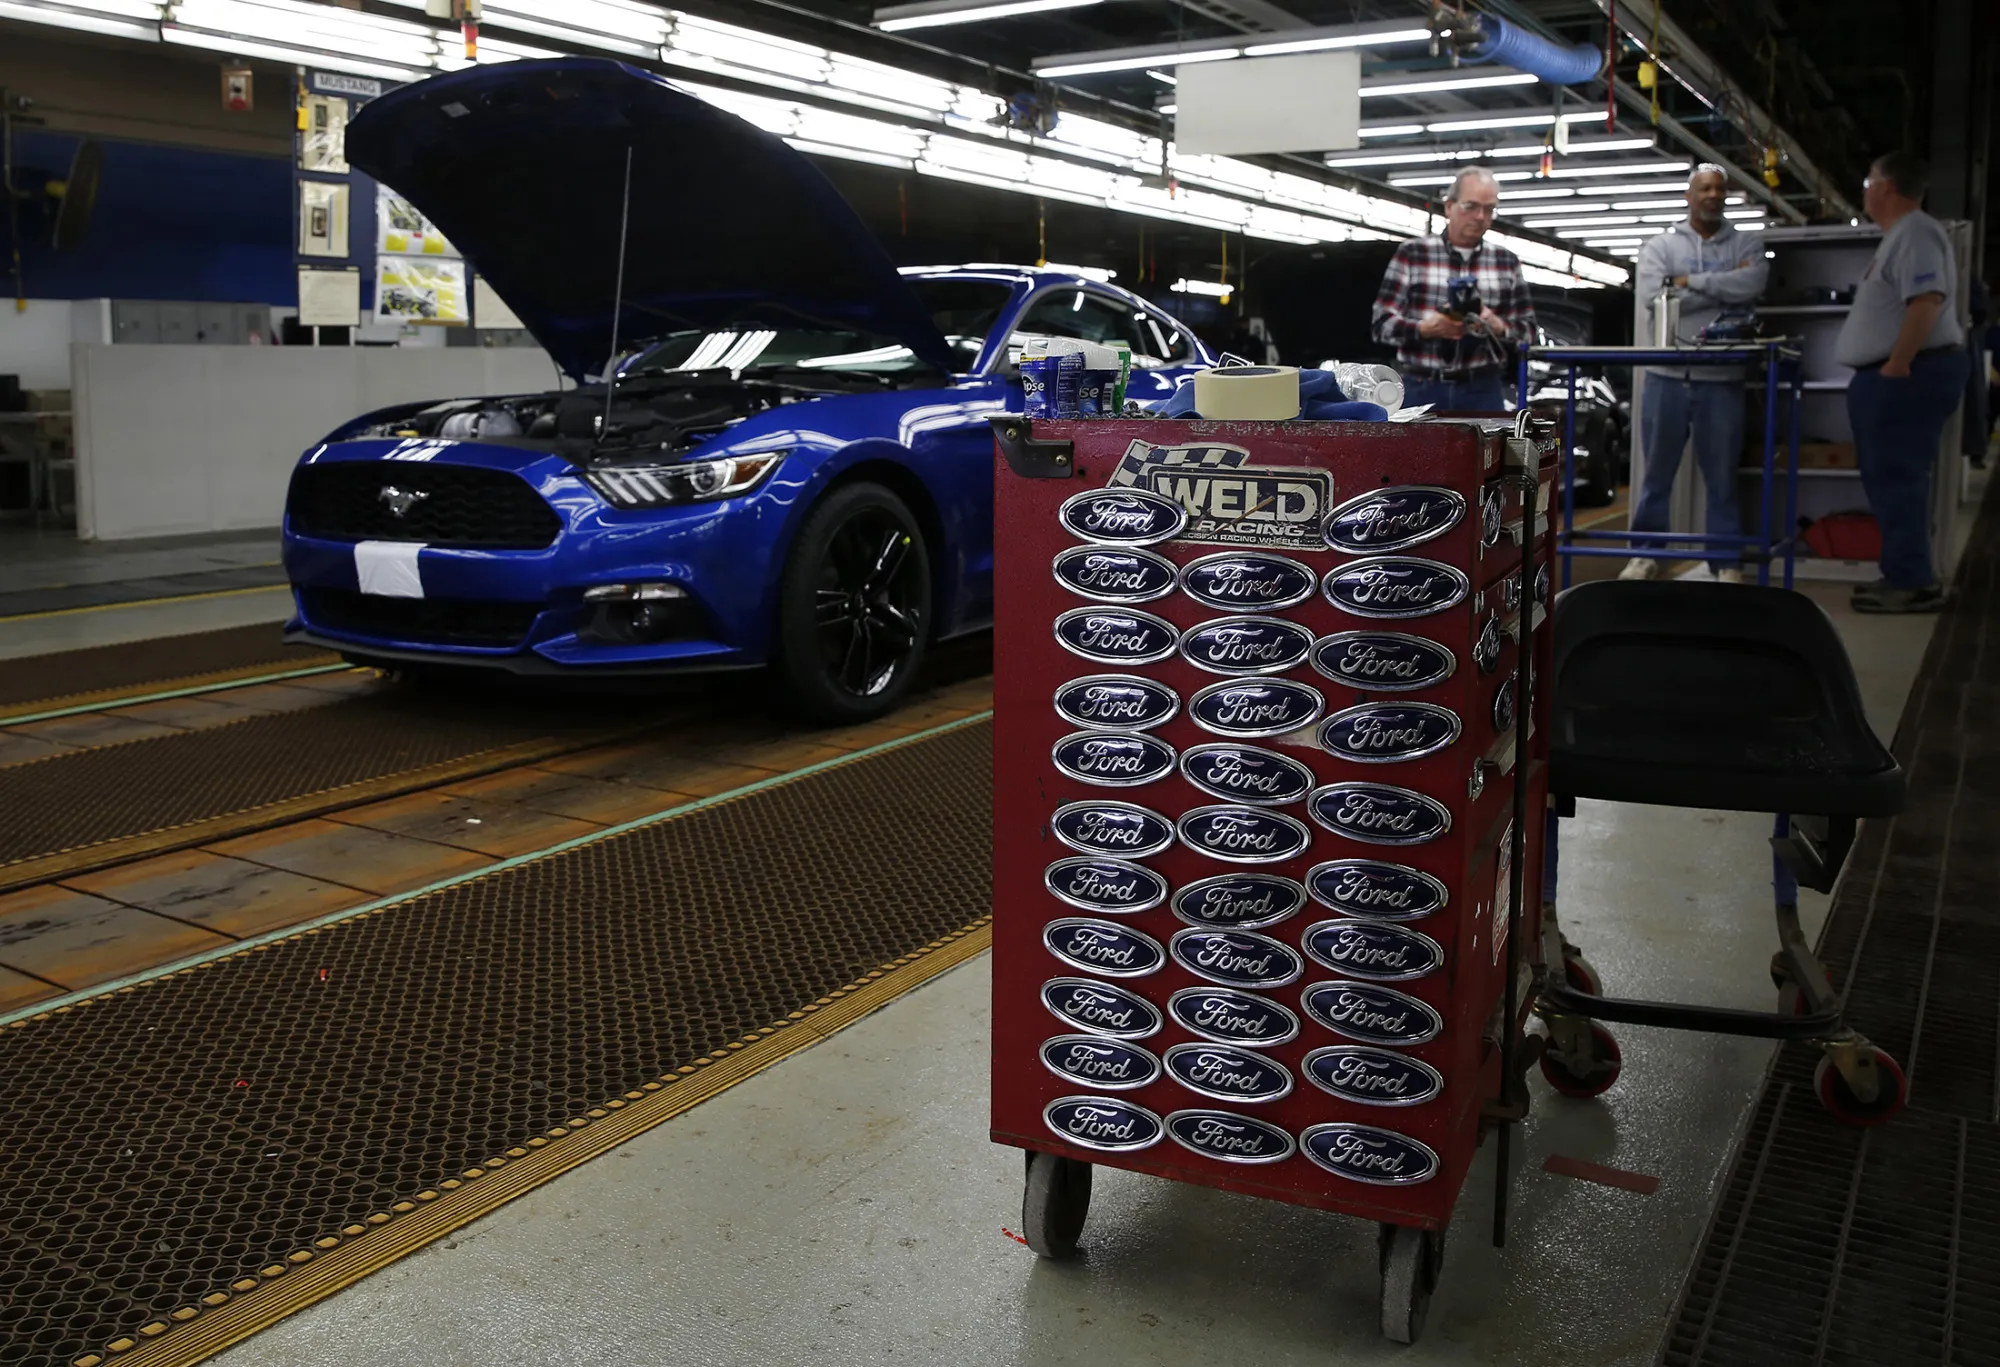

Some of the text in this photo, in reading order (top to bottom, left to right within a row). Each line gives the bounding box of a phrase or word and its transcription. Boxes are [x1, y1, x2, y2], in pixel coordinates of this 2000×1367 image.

[320, 75, 376, 92] MUSTANG
[1086, 499, 1154, 532] Ford
[1157, 477, 1317, 523] WELD
[1197, 520, 1305, 537] RACING
[1356, 500, 1430, 541] Ford
[1220, 534, 1257, 543] RACING
[1258, 536, 1302, 546] WHEELS
[1078, 556, 1148, 589] Ford
[1209, 564, 1283, 596] Ford
[1356, 569, 1434, 602] Ford
[1079, 616, 1149, 651] Ford
[1209, 627, 1282, 661] Ford
[1346, 644, 1420, 678] Ford
[1078, 688, 1148, 718] Ford
[1216, 688, 1290, 722] Ford
[1347, 714, 1426, 749] Ford
[1077, 742, 1146, 773] Ford
[1206, 754, 1281, 793] Ford
[1076, 811, 1145, 846] Ford
[1336, 793, 1416, 831] Ford
[1204, 816, 1278, 851] Ford
[1069, 866, 1138, 901] Ford
[1333, 869, 1413, 908] Ford
[1200, 885, 1275, 919] Ford
[1067, 928, 1135, 966] Ford
[1197, 934, 1271, 976] Ford
[1331, 929, 1408, 969] Ford
[1064, 988, 1133, 1028] Ford
[1194, 997, 1268, 1036] Ford
[1329, 992, 1407, 1033] Ford
[1064, 1044, 1130, 1079] Ford
[1189, 1054, 1261, 1092] Ford
[1331, 1056, 1409, 1094] Ford
[1068, 1105, 1135, 1140] Ford
[1192, 1119, 1265, 1154] Ford
[1328, 1134, 1406, 1173] Ford
